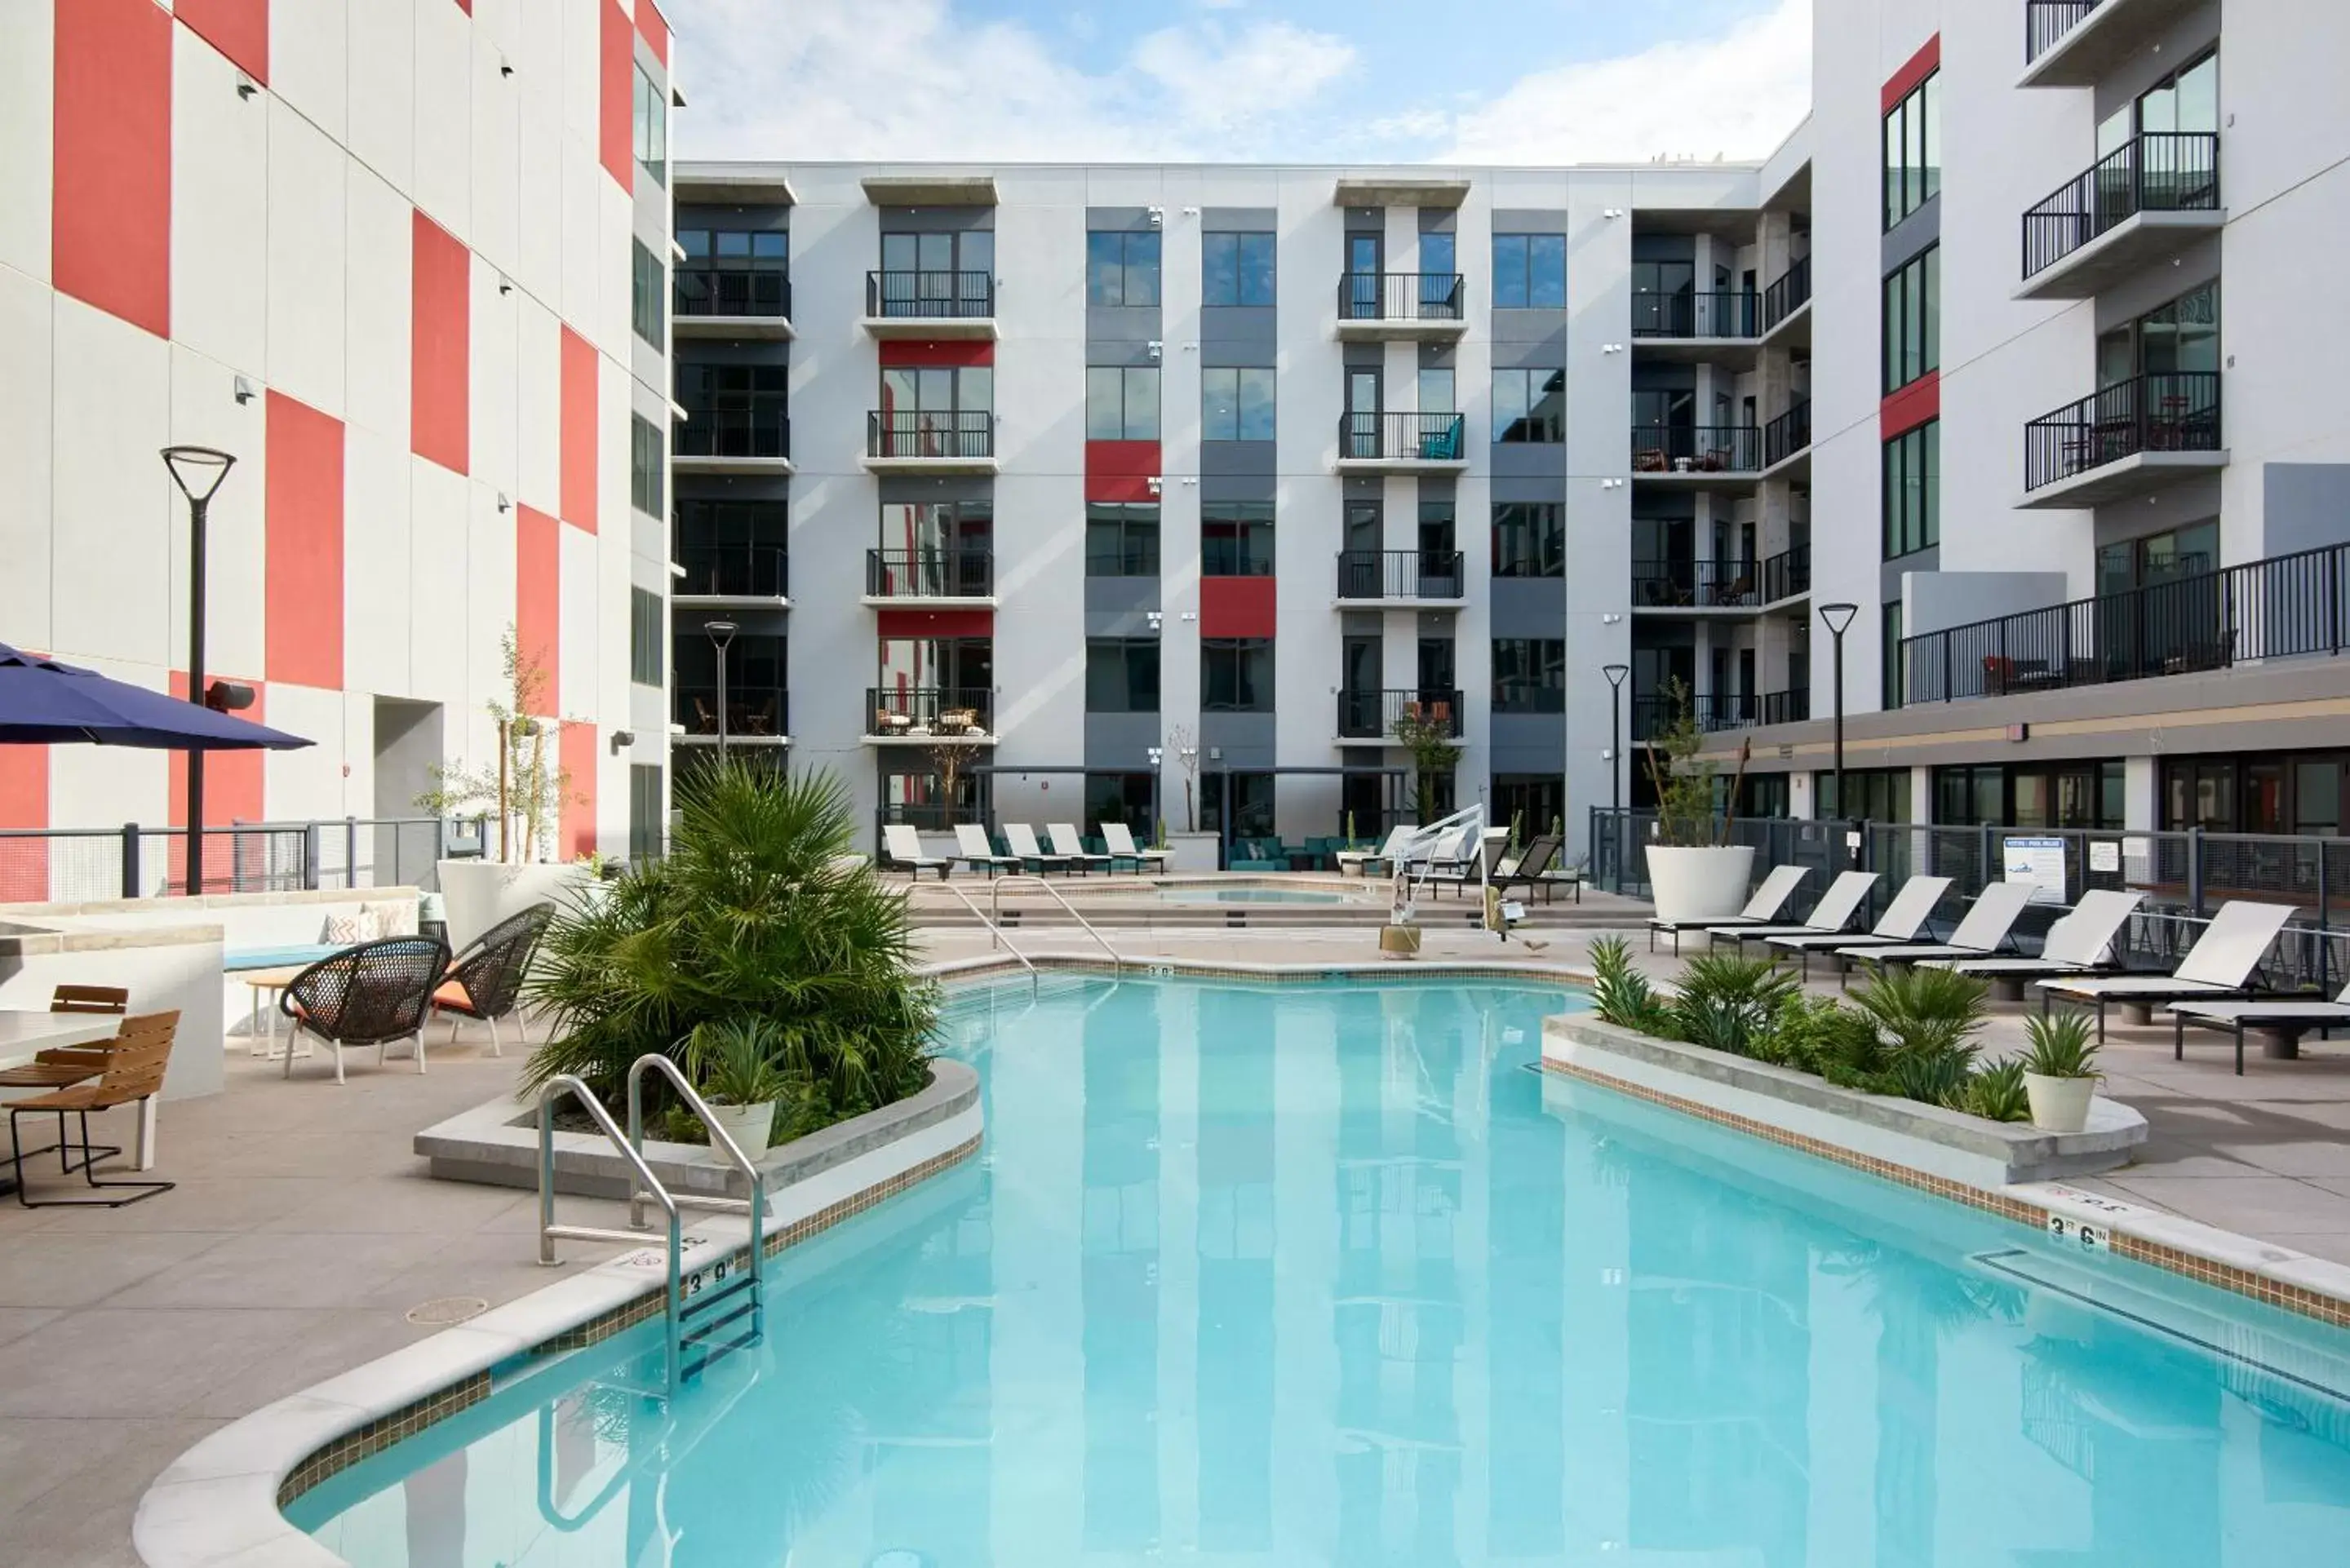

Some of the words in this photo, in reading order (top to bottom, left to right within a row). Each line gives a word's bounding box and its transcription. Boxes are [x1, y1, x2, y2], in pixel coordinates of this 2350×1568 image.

[2051, 1216, 2064, 1234] 3
[2095, 1229, 2107, 1241] IN
[690, 1273, 701, 1294] 3
